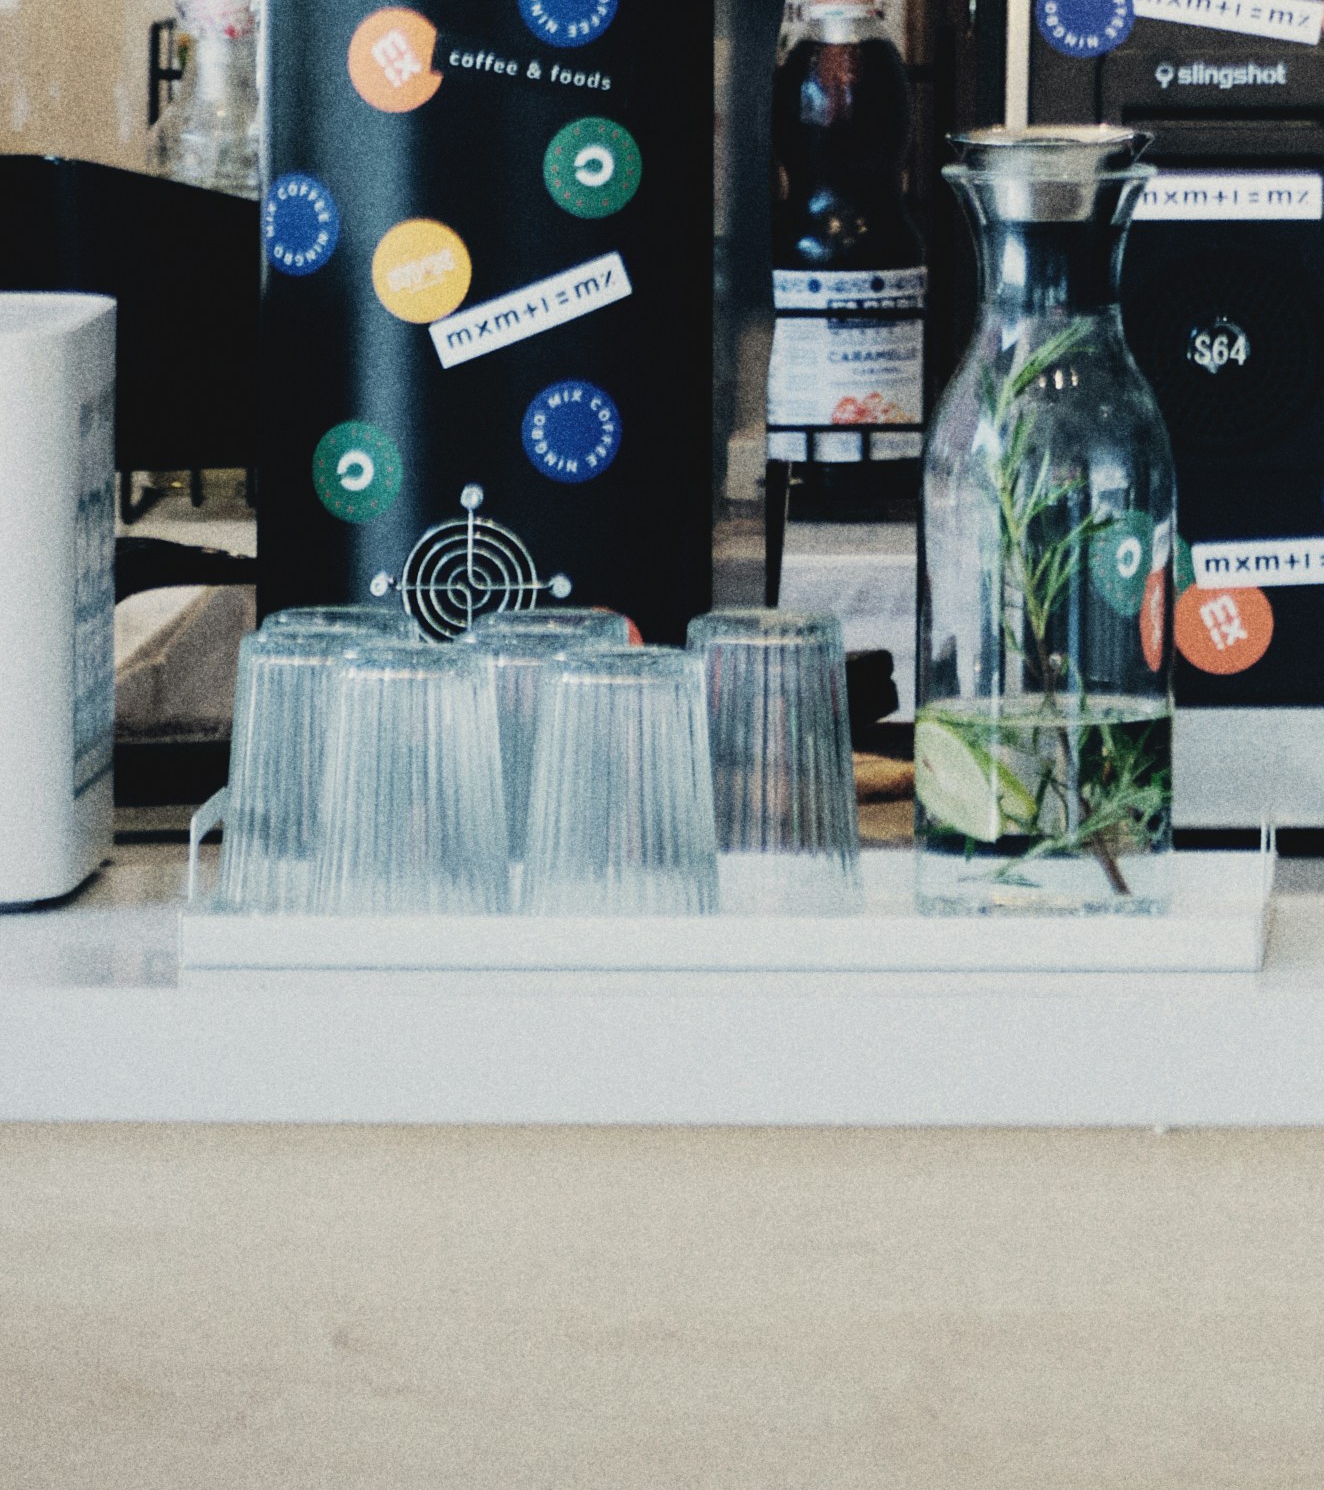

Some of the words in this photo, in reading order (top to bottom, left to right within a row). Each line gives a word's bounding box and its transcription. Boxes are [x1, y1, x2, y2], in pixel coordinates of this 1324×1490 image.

[448, 50, 519, 77] coffee
[526, 61, 542, 80] &
[549, 63, 612, 91] foods
[1177, 61, 1287, 89] slingshot
[1193, 334, 1248, 367] S64
[548, 388, 583, 409] MIX
[531, 413, 579, 474] NINGBO
[585, 396, 615, 467] COFFEE
